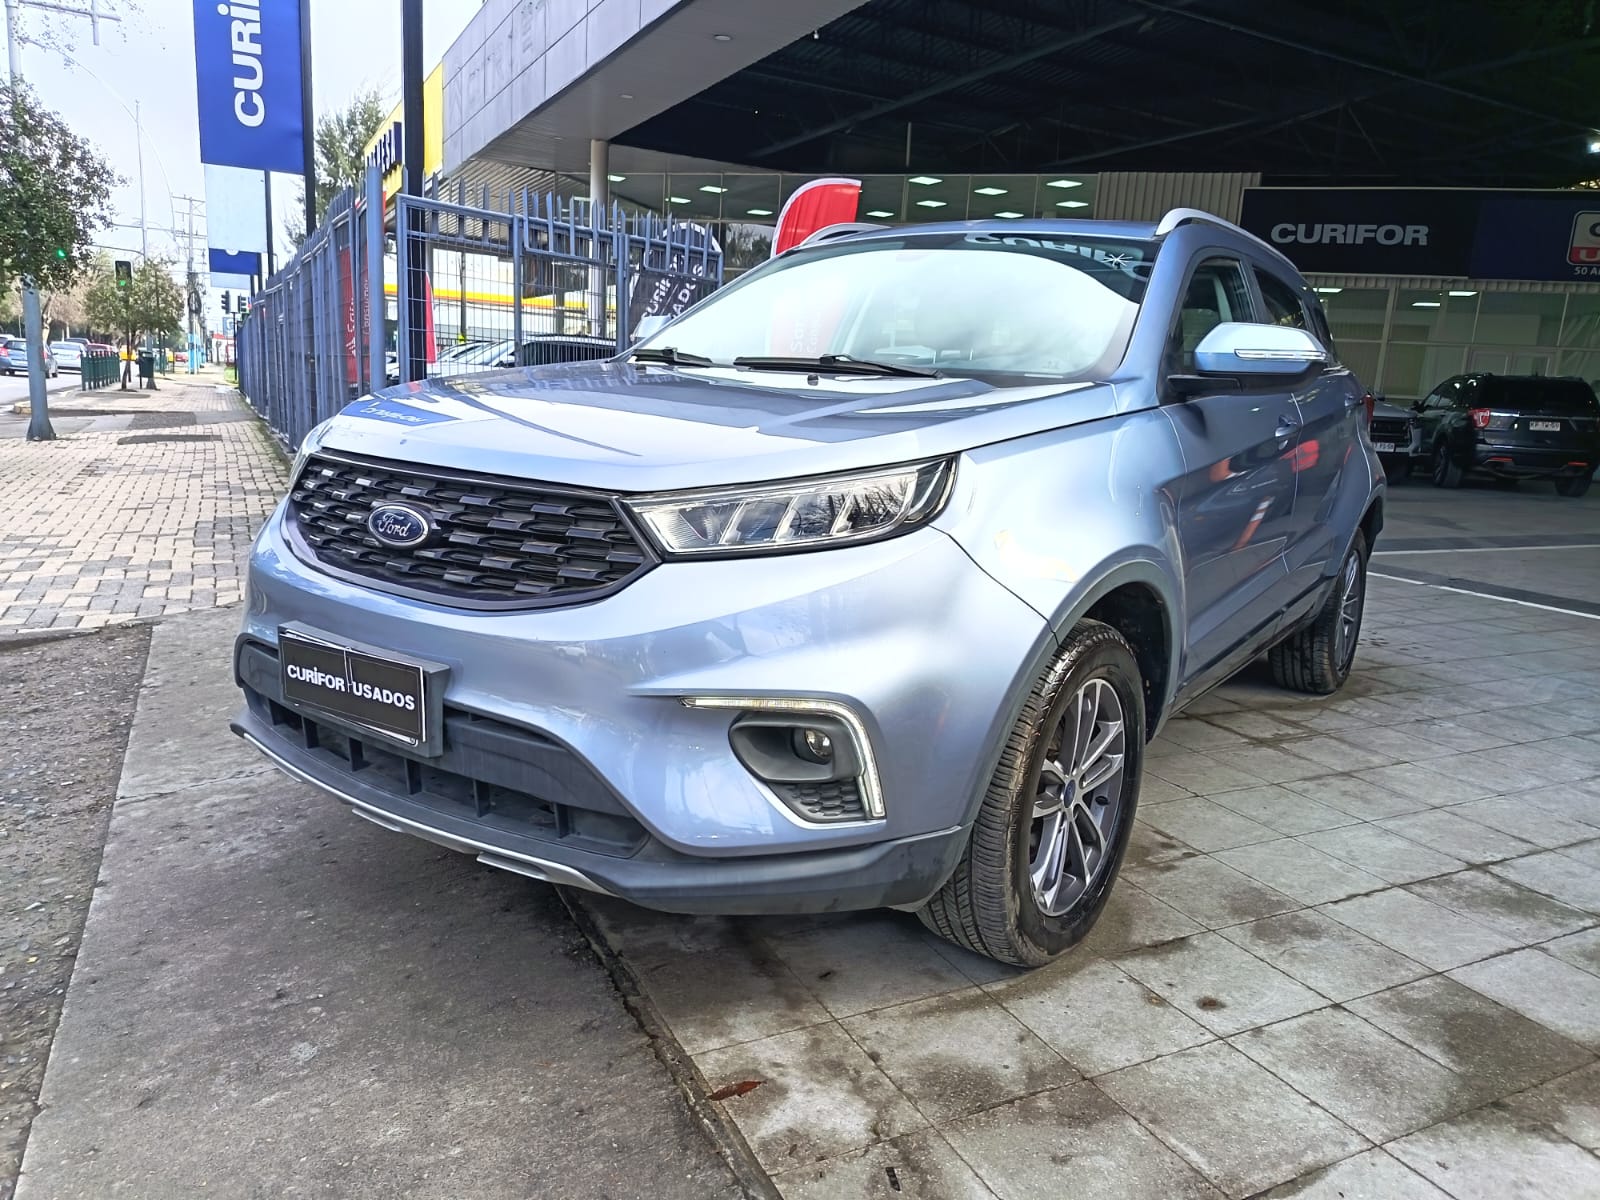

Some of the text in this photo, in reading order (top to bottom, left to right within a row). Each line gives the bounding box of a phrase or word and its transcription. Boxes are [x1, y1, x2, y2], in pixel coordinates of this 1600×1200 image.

[217, 0, 265, 127] CURi
[1270, 223, 1429, 246] CURIFOR
[377, 512, 412, 537] Ford
[352, 681, 415, 710] USADOS
